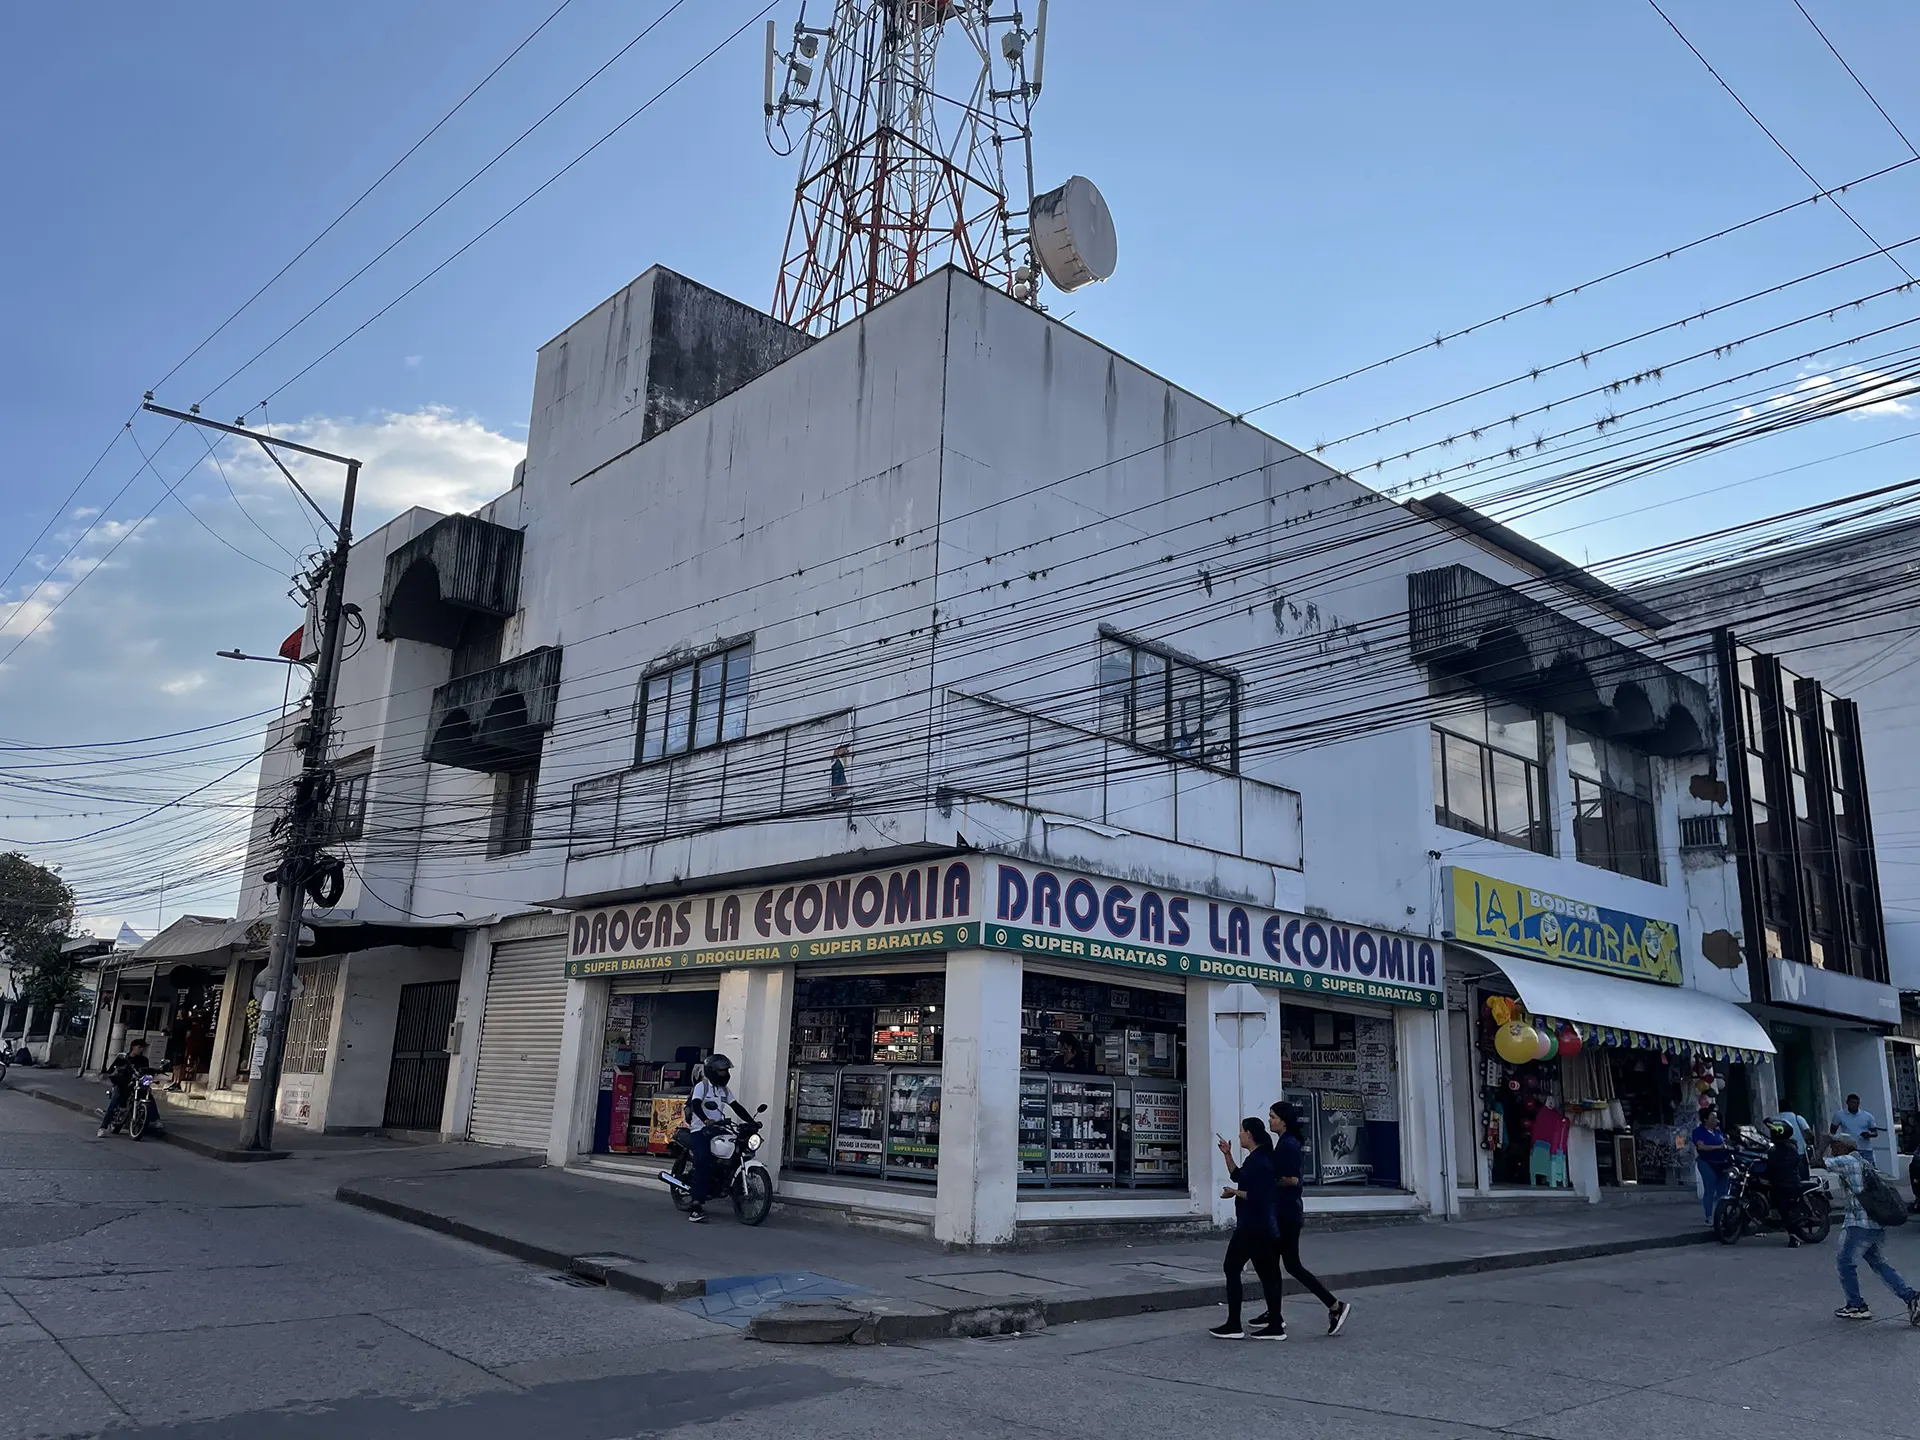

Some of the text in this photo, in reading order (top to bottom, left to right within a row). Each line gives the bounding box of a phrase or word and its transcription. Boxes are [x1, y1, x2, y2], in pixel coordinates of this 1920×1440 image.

[573, 861, 971, 956] DROGAS LA ECONOMIA
[1474, 881, 1508, 936] LA
[1529, 890, 1601, 923] BODEGA
[998, 864, 1436, 986] DROGAS LA ECONOMIA
[695, 947, 780, 965] DROGUERIA
[809, 931, 943, 956] SUPER BARATAS
[1021, 933, 1168, 967] SUPER BARATAS
[584, 955, 673, 974] SUPER BARATAS
[1200, 960, 1295, 984] DROGUERIA
[1321, 977, 1422, 1003] SUPER BARATAS
[1315, 1052, 1323, 1062] LA
[1324, 1052, 1356, 1063] ECONOMIA
